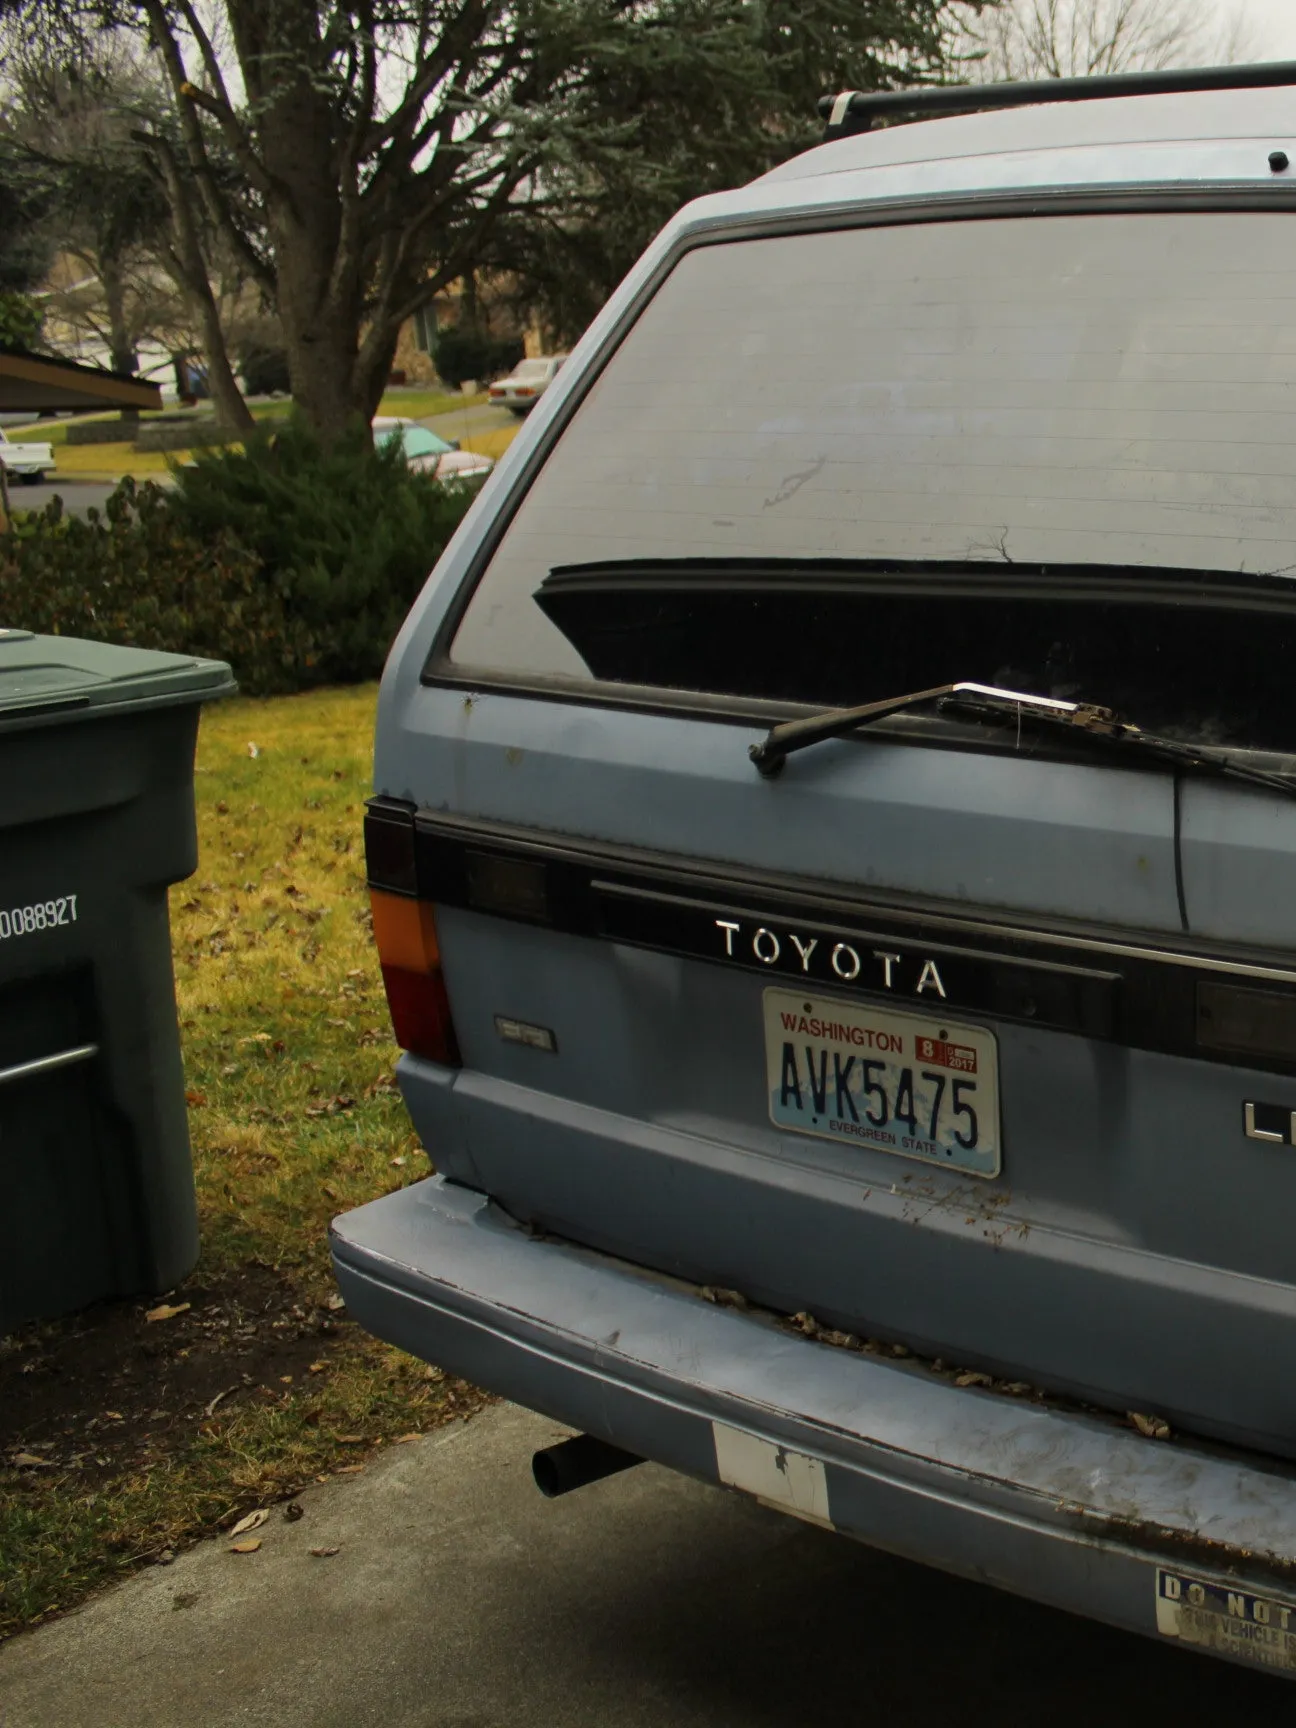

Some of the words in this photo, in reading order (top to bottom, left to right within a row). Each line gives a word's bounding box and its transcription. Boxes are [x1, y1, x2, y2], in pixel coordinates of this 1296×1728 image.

[0, 894, 77, 939] 0088927
[715, 920, 946, 998] TOYOTA
[780, 1012, 903, 1054] WASHINGTON
[921, 1039, 934, 1058] 8
[948, 1056, 974, 1072] 2017
[780, 1042, 979, 1149] AVK5475
[829, 1120, 896, 1145] EVERGREEN
[901, 1136, 937, 1155] STATE
[1164, 1574, 1205, 1606] DO
[1227, 1592, 1292, 1630] NOT
[1221, 1616, 1279, 1647] VEHICLE
